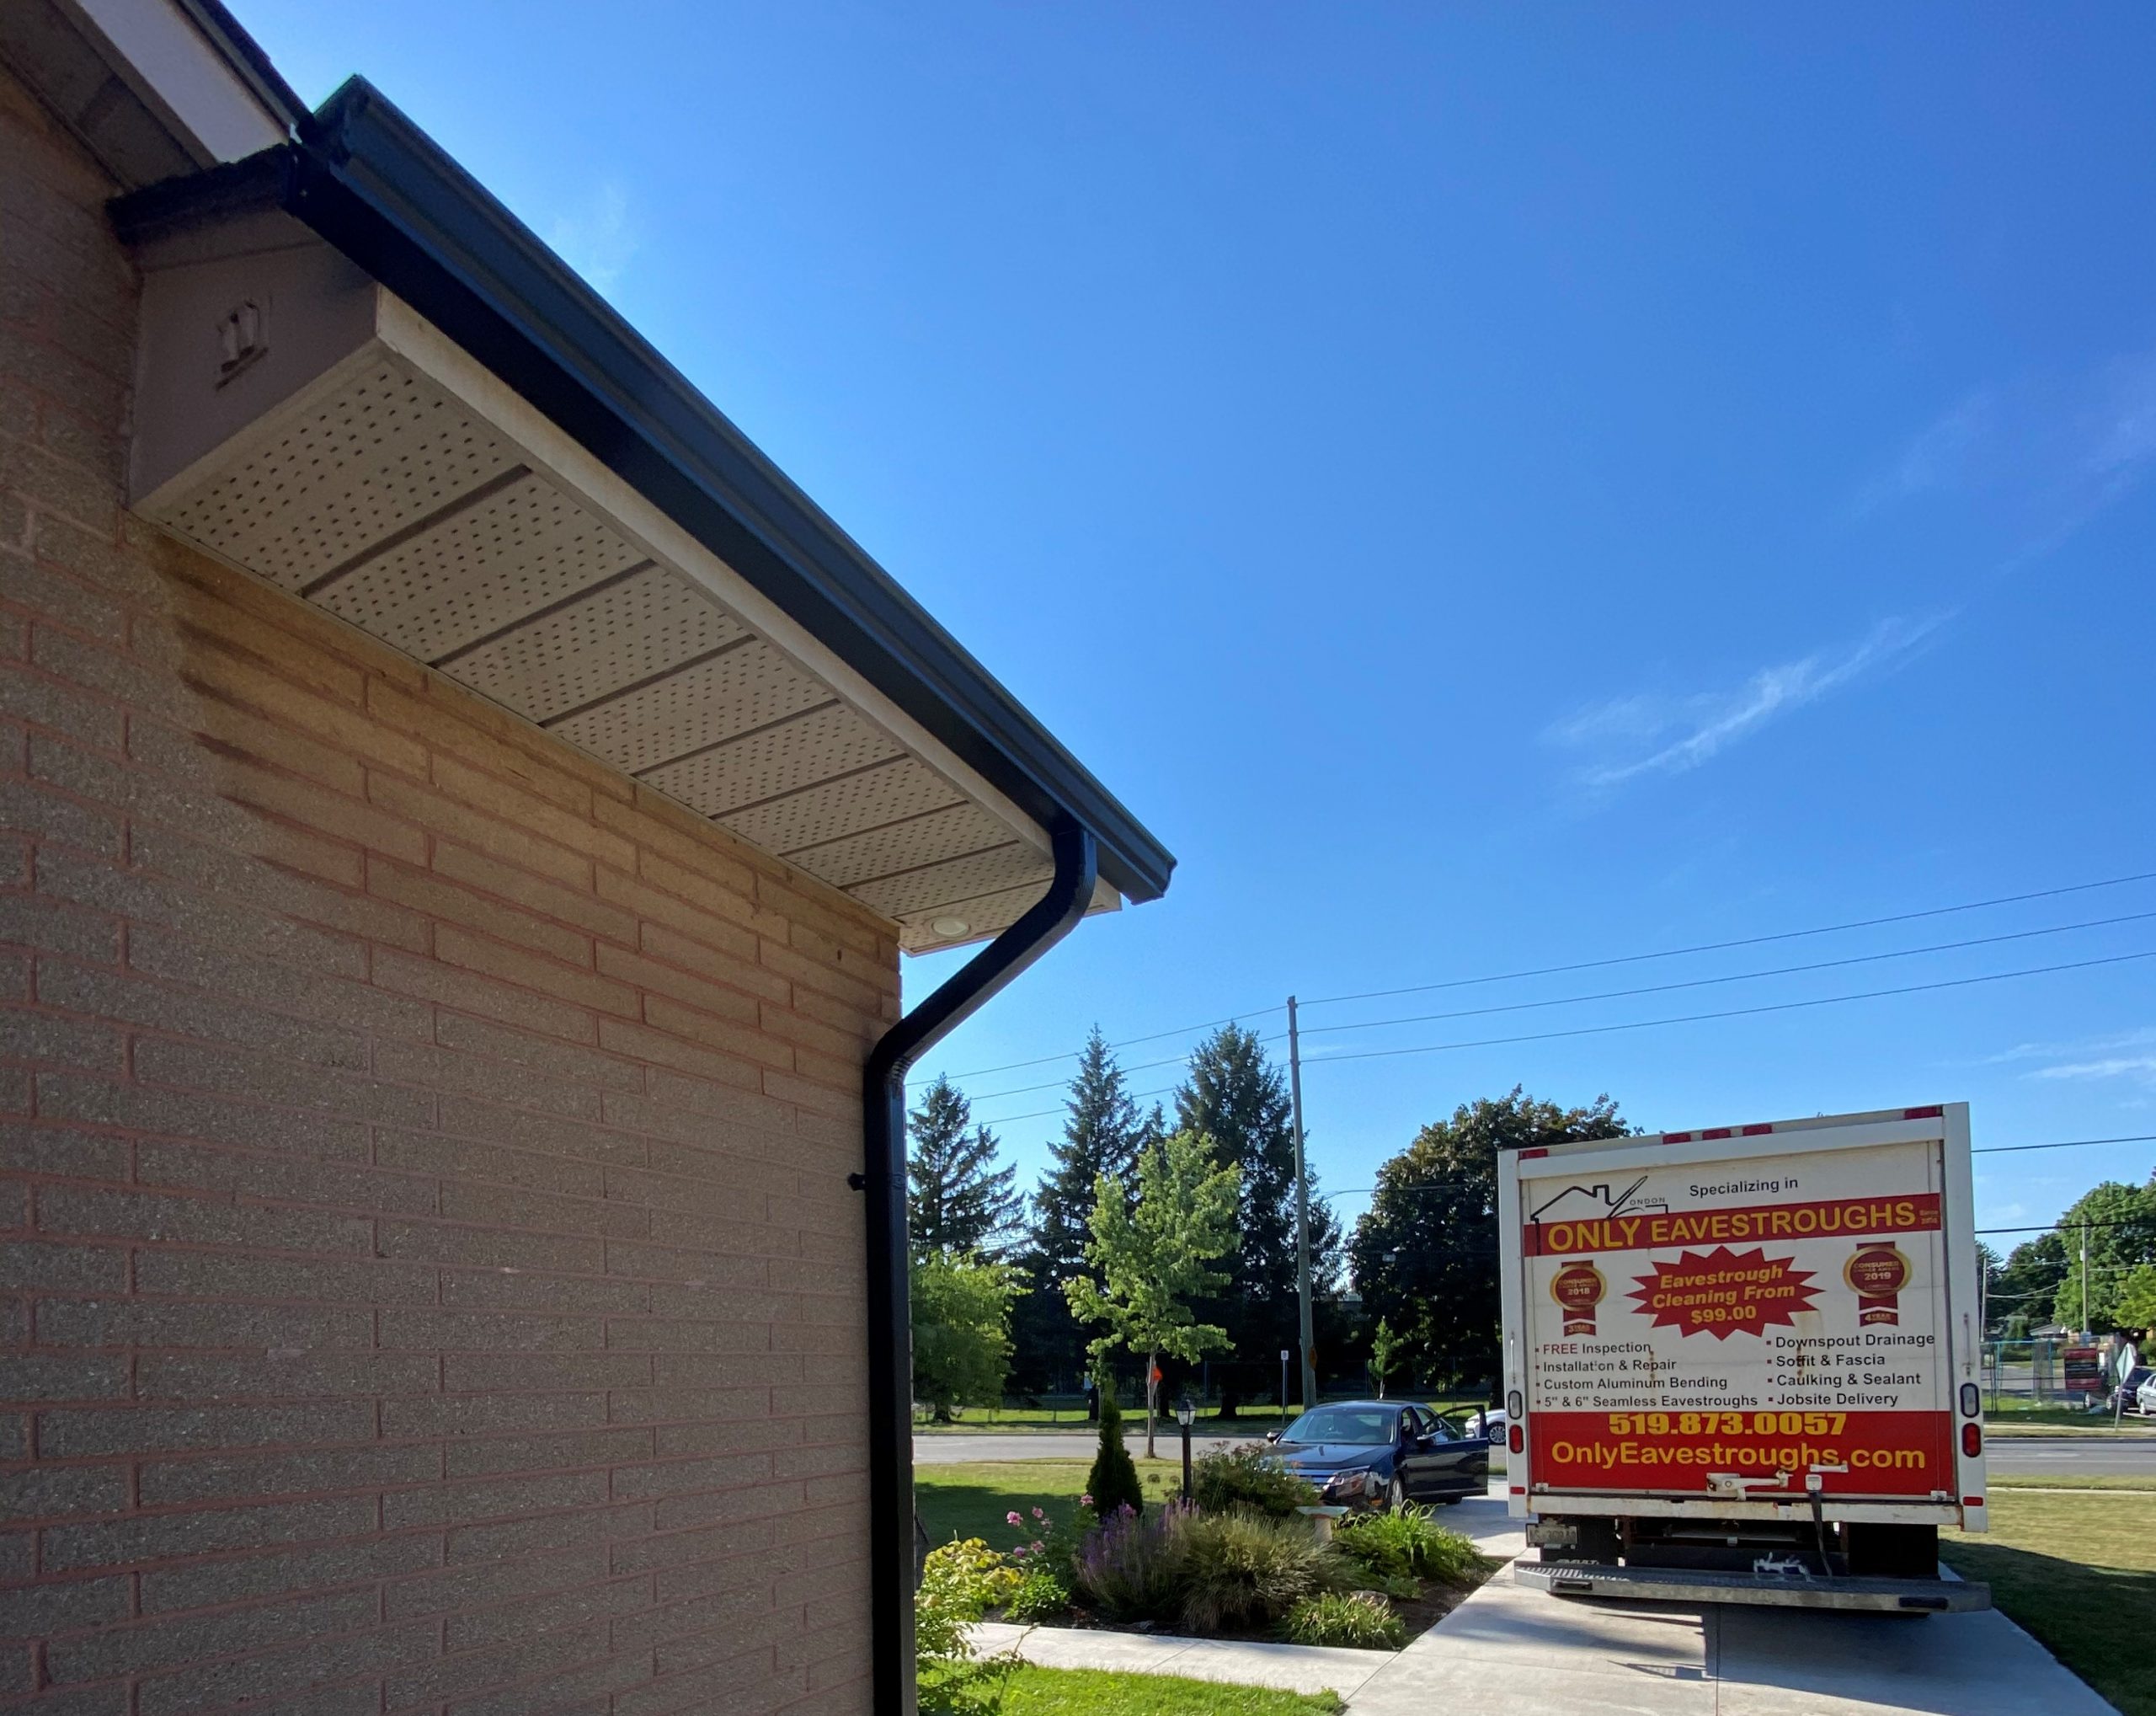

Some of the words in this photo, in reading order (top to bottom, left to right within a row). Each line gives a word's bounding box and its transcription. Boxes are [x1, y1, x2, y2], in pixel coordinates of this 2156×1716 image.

[1689, 1180, 1780, 1199] Specializing
[1785, 1177, 1799, 1189] in
[1548, 1217, 1641, 1252] ONLY
[1651, 1201, 1916, 1243] EAVESTROUGHS
[1660, 1264, 1784, 1290] Eavestrough
[1864, 1271, 1892, 1281] 2019
[1567, 1287, 1591, 1296] 2018
[1652, 1290, 1737, 1309] Cleaning
[1743, 1286, 1796, 1301] From
[1690, 1305, 1757, 1325] $99.00
[1543, 1343, 1578, 1355] FREE
[1582, 1341, 1652, 1355] Inspection
[1775, 1334, 1860, 1350] Downspout
[1865, 1334, 1935, 1348] Drainage
[1544, 1360, 1614, 1372] Installation
[1619, 1360, 1628, 1371] &
[1633, 1358, 1677, 1372] Repair
[1776, 1354, 1816, 1367] Soffit
[1820, 1354, 1831, 1366] &
[1836, 1353, 1886, 1366] Fascia
[1544, 1378, 1594, 1390] Custom
[1597, 1377, 1665, 1389] Aluminum
[1669, 1377, 1728, 1390] Bending
[1776, 1374, 1842, 1388] Caulking
[1847, 1373, 1858, 1386] &
[1863, 1372, 1921, 1385] Sealant
[1544, 1395, 1558, 1408] 5"
[1561, 1395, 1572, 1407] &
[1575, 1395, 1589, 1407] 6"
[1593, 1395, 1657, 1407] Seamless
[1662, 1394, 1758, 1409] Eavestroughs
[1777, 1393, 1832, 1405] Jobsite
[1837, 1392, 1898, 1407] Delivery
[1609, 1412, 1847, 1435] 519.873.0057
[1551, 1441, 1926, 1471] OnlyEavestroughs.com
